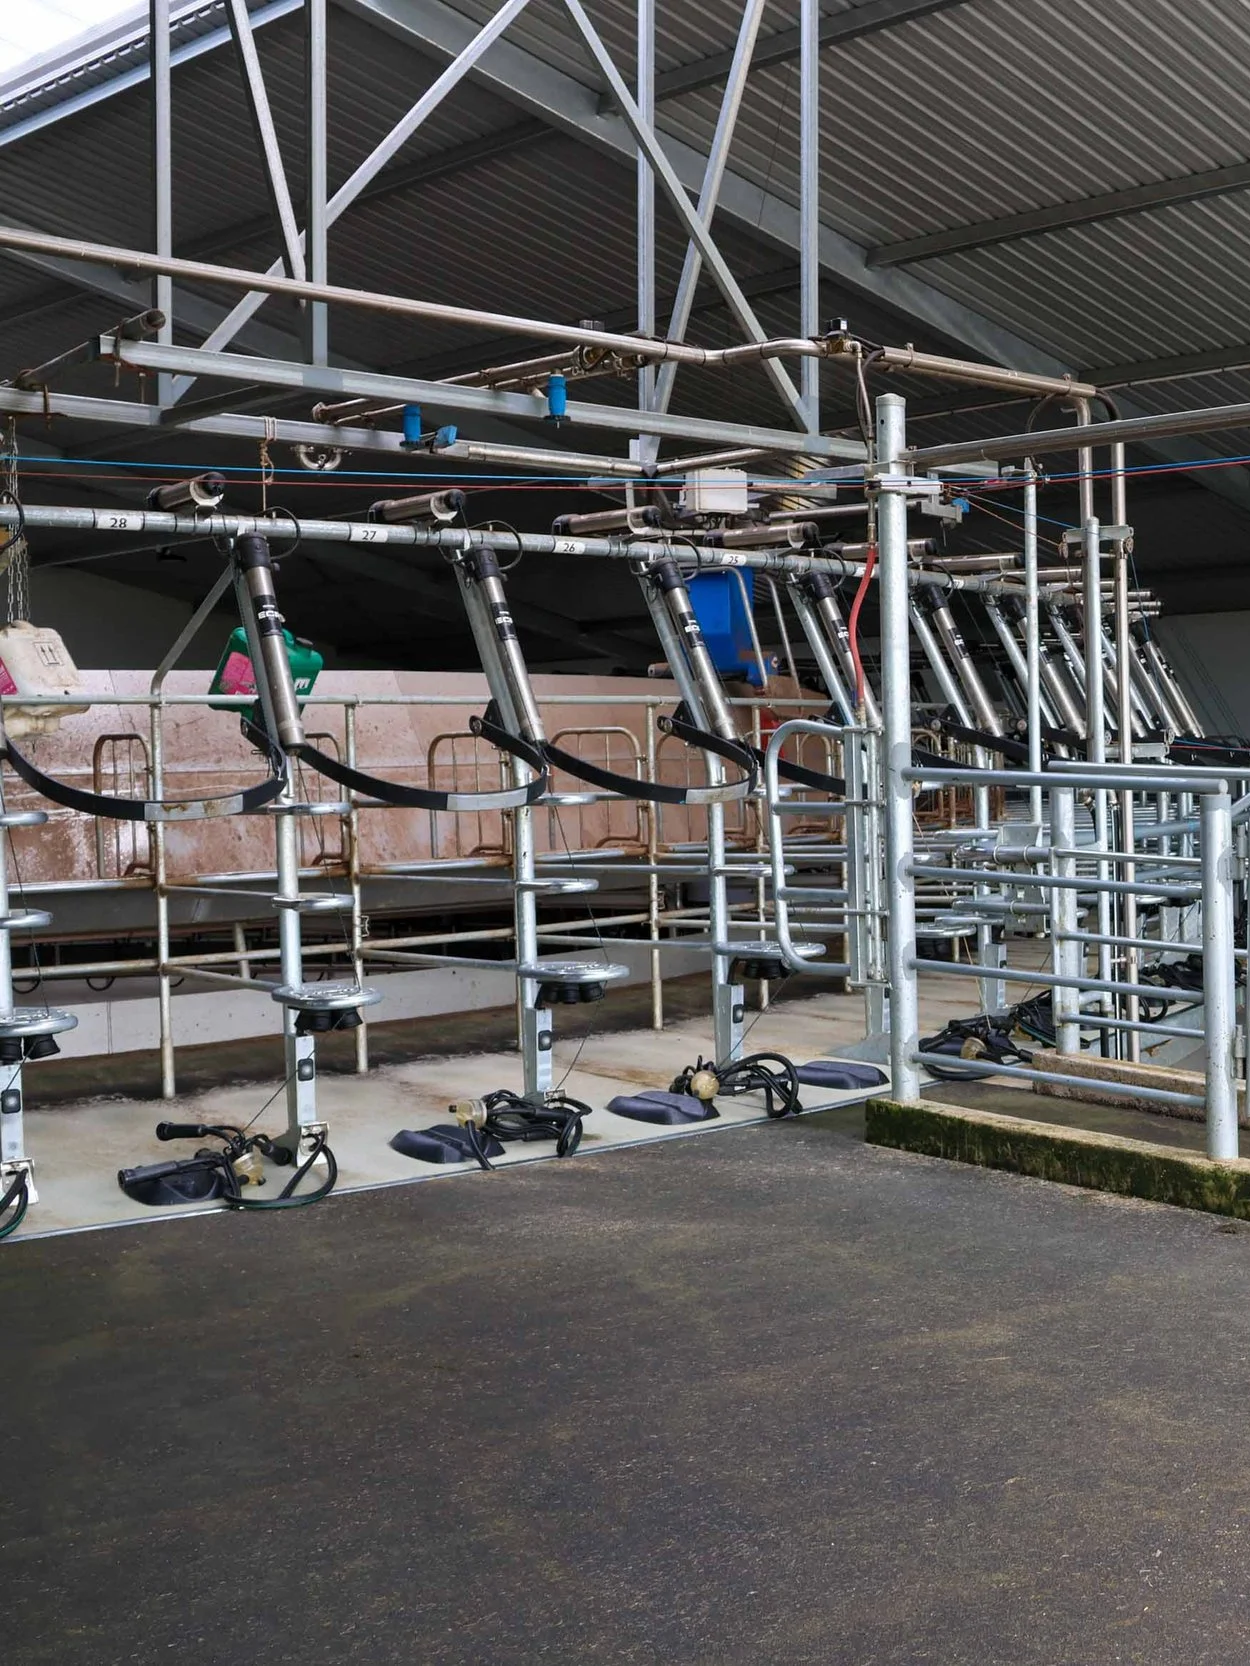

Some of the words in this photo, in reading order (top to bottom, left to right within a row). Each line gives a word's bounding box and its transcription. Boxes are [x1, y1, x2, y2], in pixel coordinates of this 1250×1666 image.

[110, 517, 127, 528] 28
[362, 530, 377, 541] 27
[563, 542, 576, 554] 26
